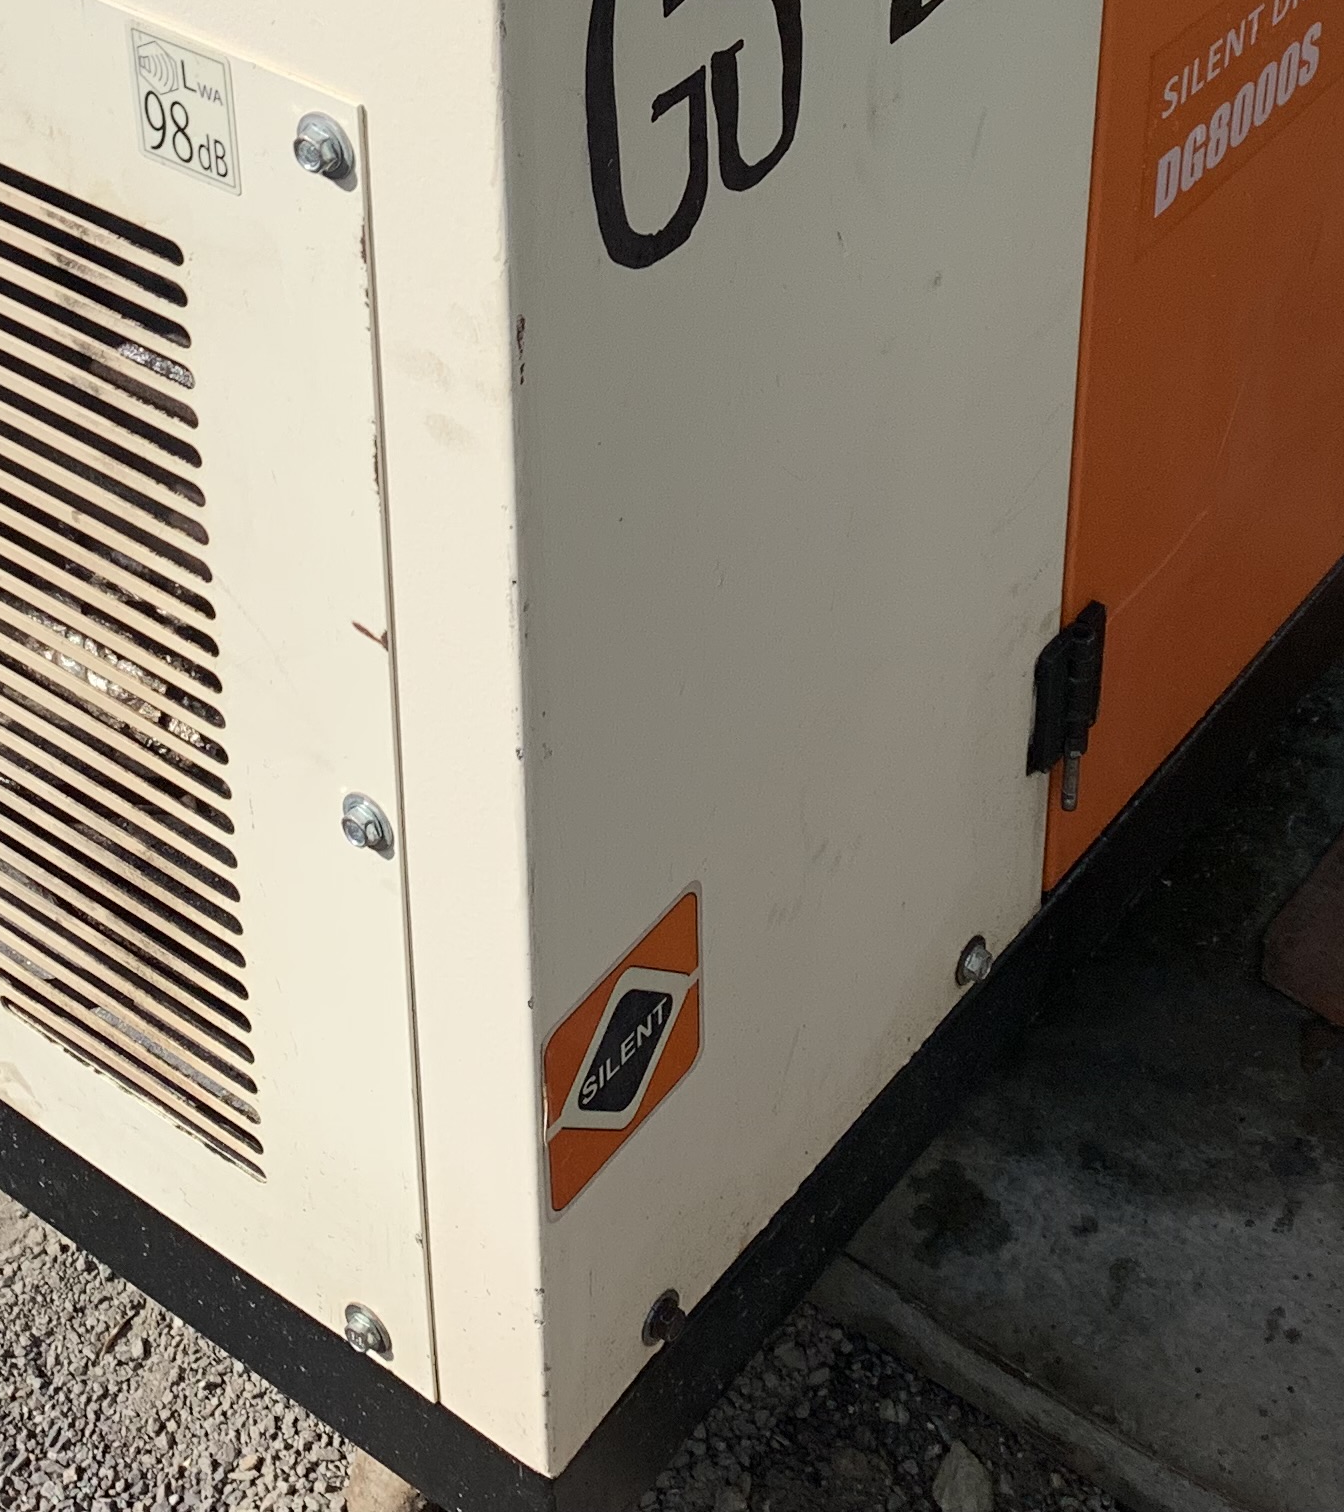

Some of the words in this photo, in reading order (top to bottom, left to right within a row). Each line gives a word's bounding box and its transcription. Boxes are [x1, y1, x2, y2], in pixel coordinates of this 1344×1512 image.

[1162, 3, 1265, 119] SILENT
[1154, 22, 1323, 219] DG8000S
[581, 996, 668, 1106] SILENT
